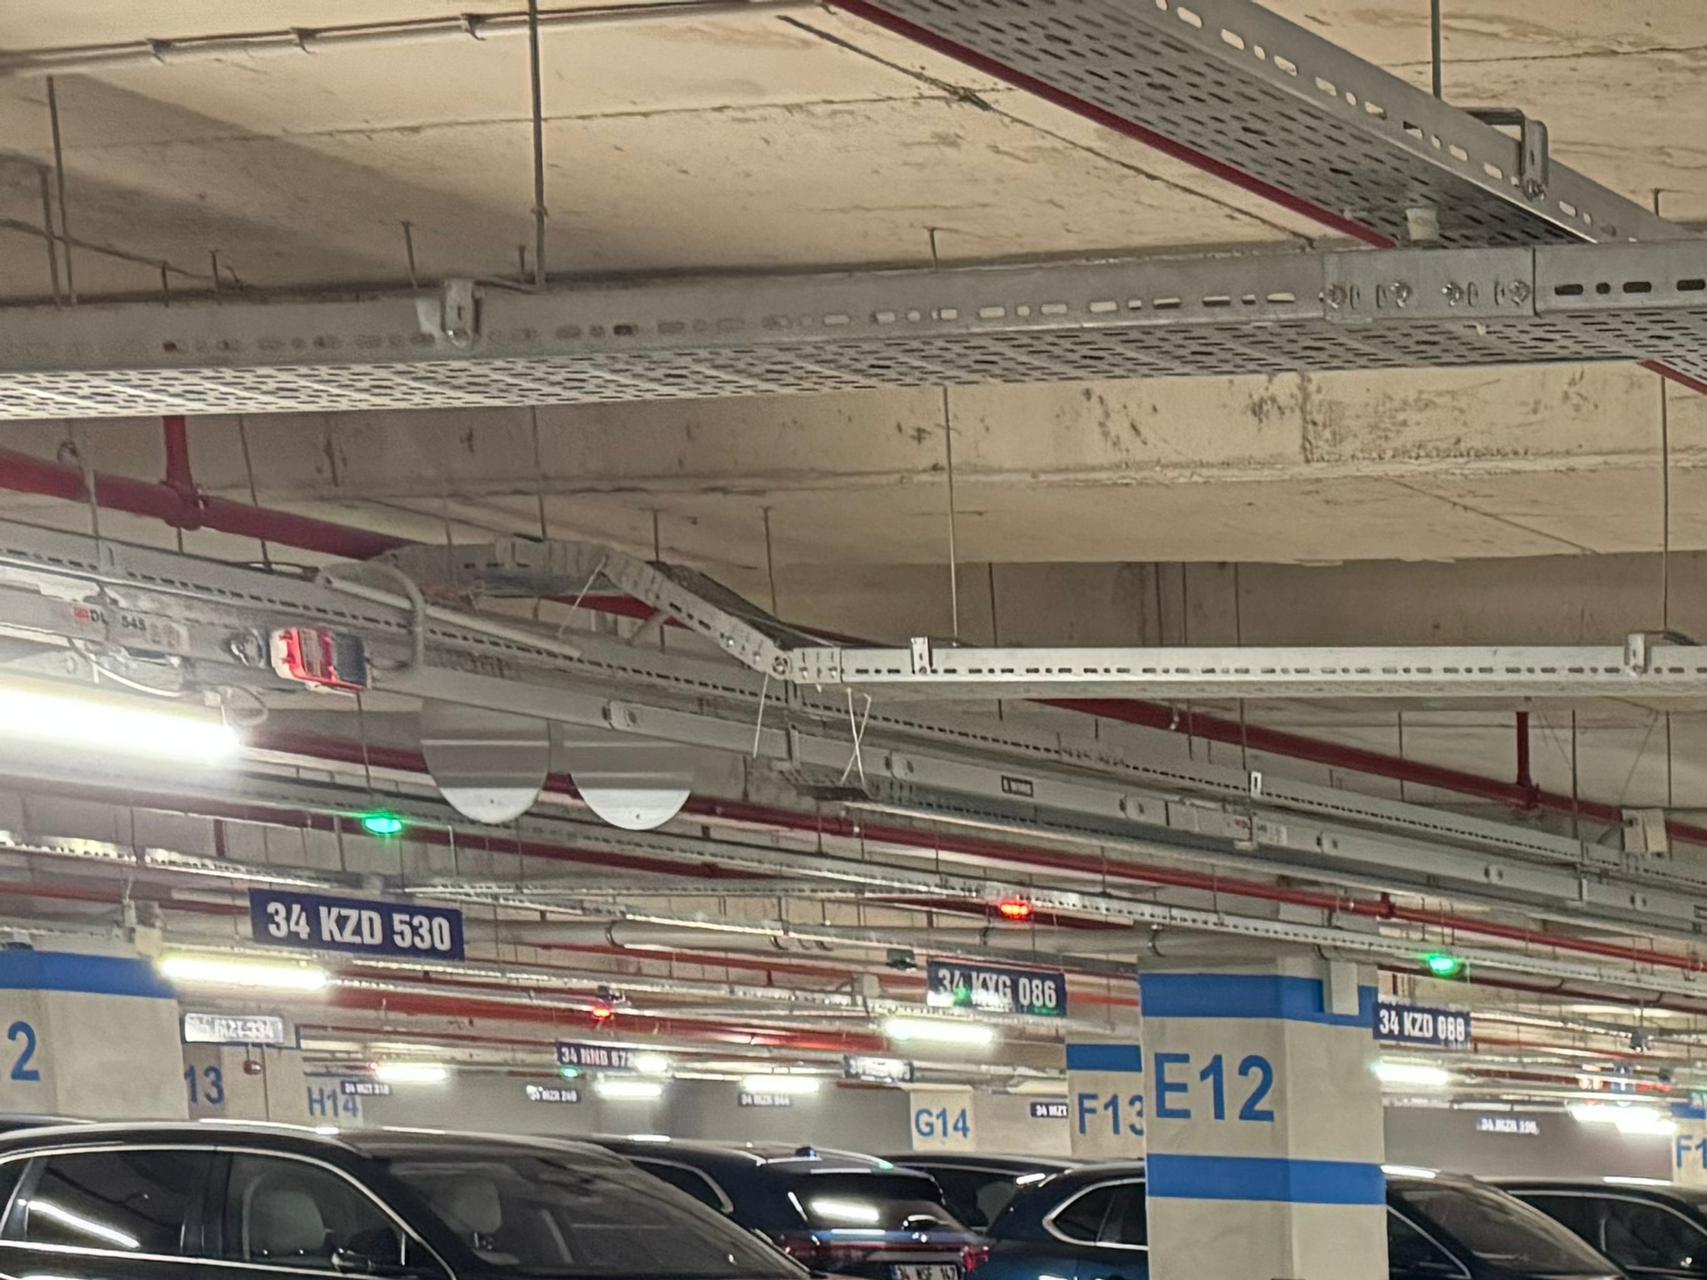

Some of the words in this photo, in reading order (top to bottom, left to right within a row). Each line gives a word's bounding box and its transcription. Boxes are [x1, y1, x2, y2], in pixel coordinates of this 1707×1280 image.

[266, 902, 310, 940] 34
[319, 906, 383, 945] KZD
[392, 913, 451, 951] 530
[1019, 976, 1057, 1008] 086
[1379, 1009, 1399, 1036] 34
[1404, 1012, 1433, 1038] KZD
[8, 1021, 40, 1081] 2
[184, 1064, 225, 1104] 13
[307, 1085, 359, 1118] H14
[1154, 1053, 1275, 1122] E12
[915, 1108, 971, 1138] G14
[1078, 1093, 1144, 1136] F13
